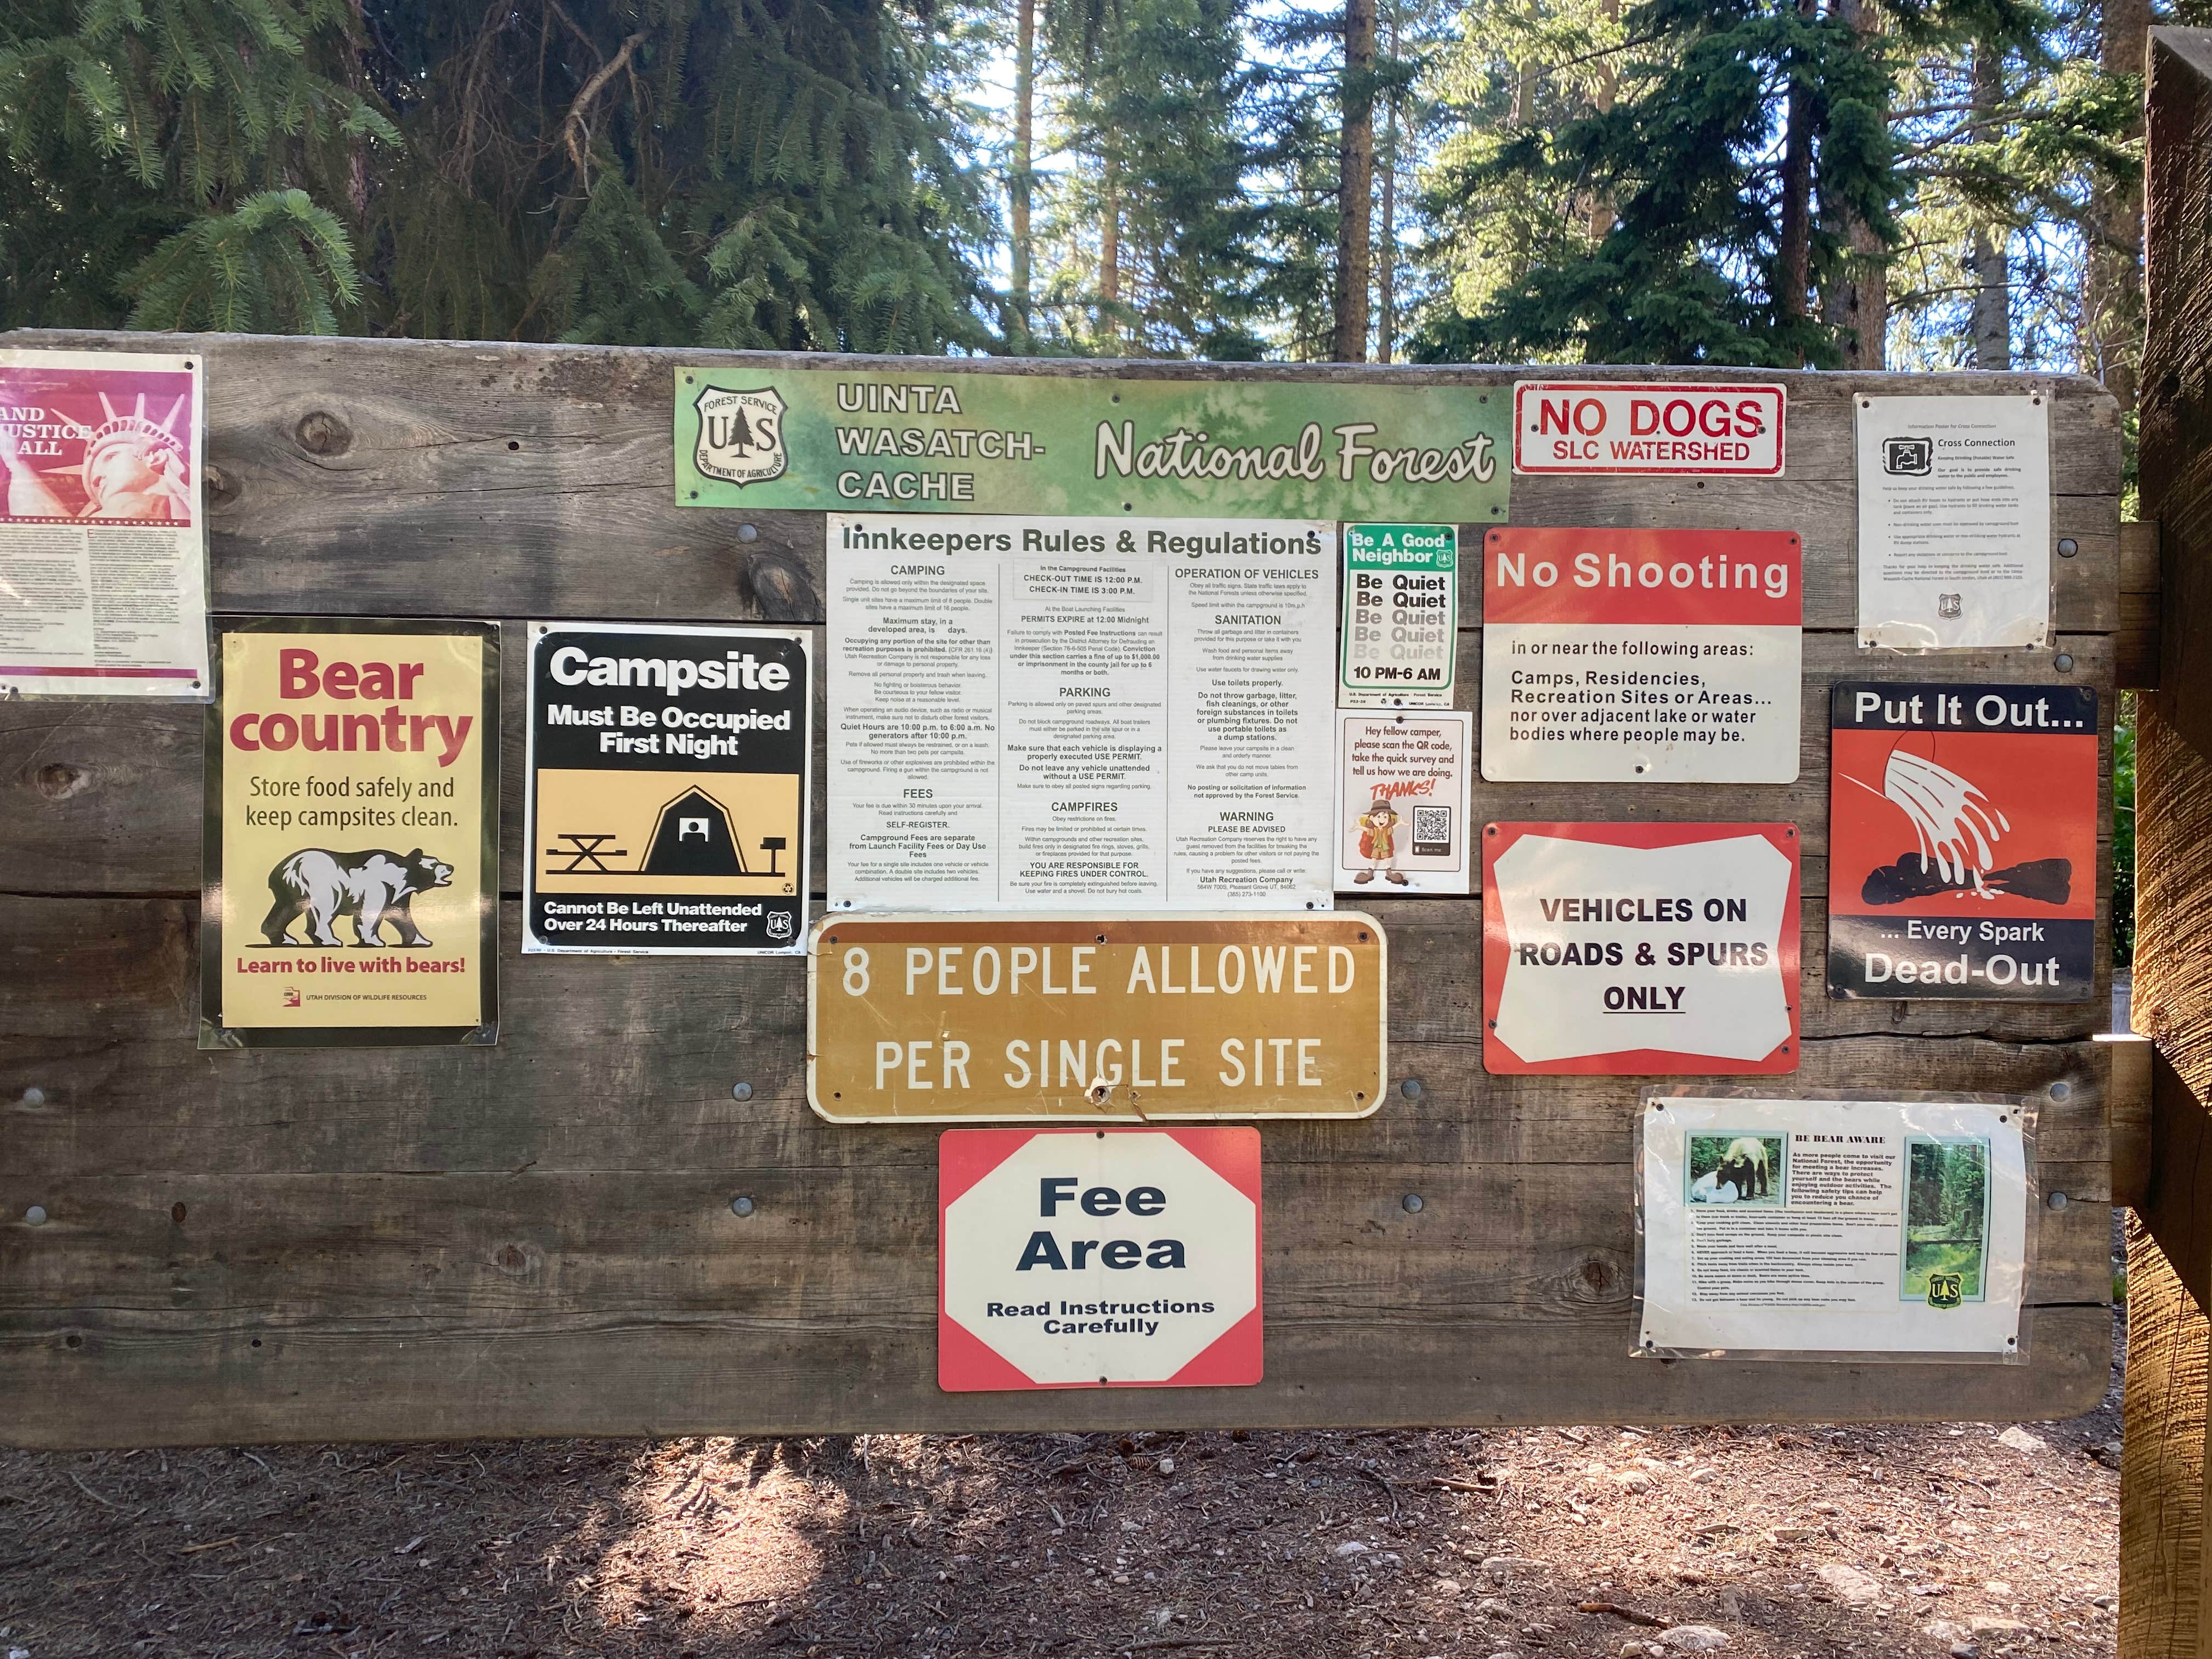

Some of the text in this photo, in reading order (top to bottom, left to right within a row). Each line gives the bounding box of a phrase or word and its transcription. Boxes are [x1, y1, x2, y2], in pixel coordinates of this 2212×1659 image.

[704, 395, 777, 415] FOREST SERVICE
[837, 383, 962, 414] UINTA
[1539, 399, 1763, 438] NO DOGS
[17, 441, 62, 456] ALL
[834, 427, 1046, 460] WASATCH-
[1554, 441, 1750, 460] SLC WATERSHED
[1965, 438, 2015, 447] Connection
[1096, 419, 1496, 484] National Forest
[836, 470, 975, 501] CACHE
[844, 527, 1321, 556] Innkeepers Rules & Regulations
[1352, 533, 1445, 548] Be A Good
[1353, 549, 1432, 565] Neighbor
[891, 566, 944, 575] CAMPING
[1176, 569, 1318, 579] OPERATION OF VEHICLES
[1498, 553, 1787, 597] No Shooting
[1357, 574, 1445, 590] Be Quiet
[1357, 591, 1445, 607] Be Quiet
[1215, 615, 1280, 624] SANITATION
[1356, 610, 1445, 625] Be Quiet
[1355, 627, 1444, 642] Be Quiet
[1354, 644, 1443, 659] Be Quiet
[1513, 641, 1752, 658] in or near the following areas:
[280, 649, 424, 699] Bear
[550, 647, 789, 695] Campsite
[1354, 667, 1370, 678] 10
[1417, 669, 1440, 680] AM
[1512, 671, 1705, 687] Camps, Residencies,
[1060, 688, 1110, 697] PARKING
[1512, 690, 1770, 704] Recreation Sites or Areas...
[1511, 709, 1756, 724] nor over adjacent lake or water
[1856, 692, 2083, 727] Put It Out...
[548, 704, 790, 733] Must Be Occupied
[230, 706, 473, 768] country
[1365, 726, 1441, 738] Hey fellow camper,
[1510, 727, 1744, 744] bodies where people may be.
[600, 732, 738, 759] First Night
[1355, 740, 1380, 749] please
[1402, 741, 1414, 749] the
[1431, 742, 1452, 751] code,
[1352, 753, 1454, 765] take the quick survey and
[1353, 766, 1364, 776] tell
[1378, 766, 1395, 776] how
[1428, 768, 1453, 779] doing.
[251, 776, 453, 802] Store food safely and
[904, 789, 933, 798] FEES
[1370, 779, 1436, 800] THANKS!
[1052, 803, 1118, 811] CAMPFIRES
[247, 805, 457, 831] keep campsites clean.
[1220, 812, 1273, 821] WARNING
[544, 901, 761, 916] Cannot Be Left Unattended
[1540, 899, 1746, 922] VEHICLES ON
[545, 918, 747, 932] Over 24 Hours Thereafter
[1907, 920, 1972, 945] Every
[1979, 921, 2045, 945] Spark
[1520, 943, 1767, 966] ROADS & SPURS
[238, 957, 464, 973] Learn to live with bears!
[843, 945, 1354, 996] 8 PEOPLE ALLOWED
[1865, 953, 2060, 986] Dead-Out
[1604, 987, 1685, 1009] ONLY
[876, 1039, 1321, 1090] PER SINGLE SITE
[1041, 1178, 1166, 1217] Fee
[1015, 1231, 1186, 1271] Area
[988, 1300, 1214, 1317] Read Instructions
[1044, 1318, 1159, 1336] Carefully
